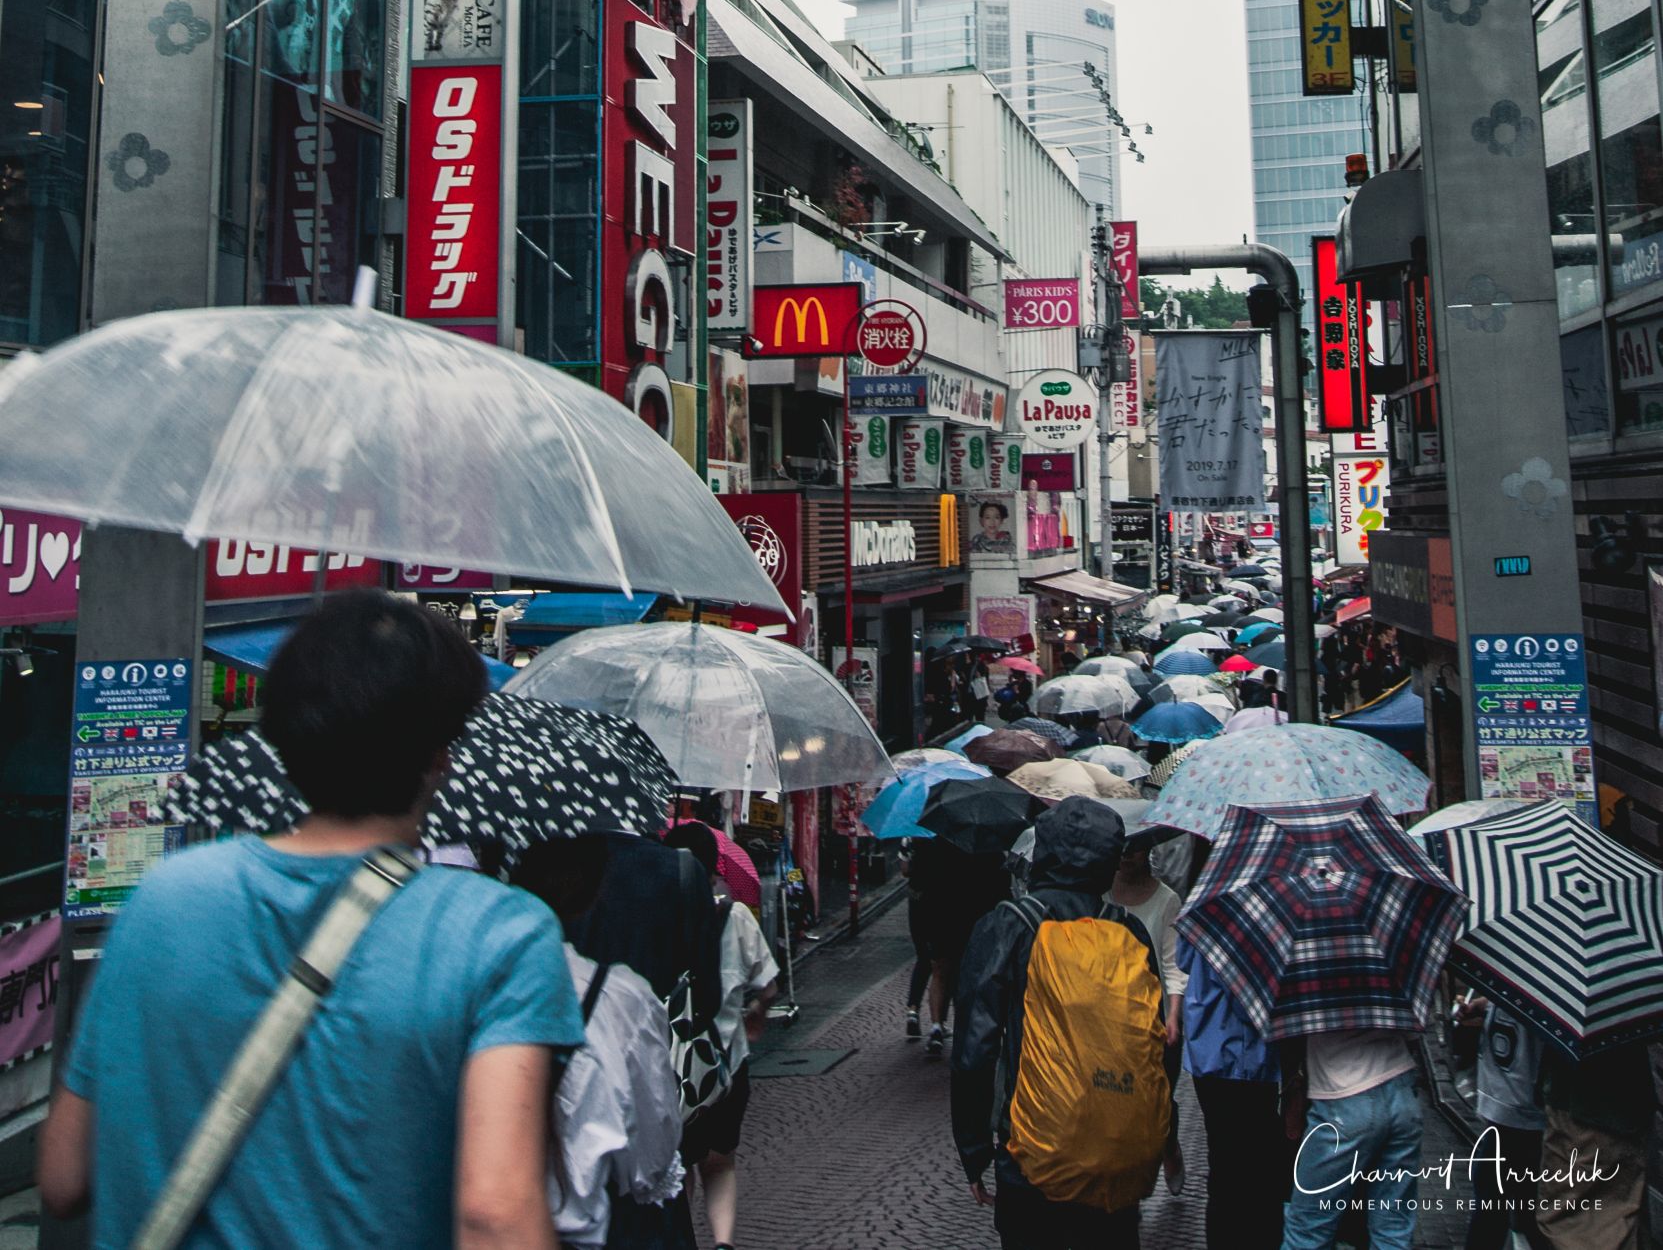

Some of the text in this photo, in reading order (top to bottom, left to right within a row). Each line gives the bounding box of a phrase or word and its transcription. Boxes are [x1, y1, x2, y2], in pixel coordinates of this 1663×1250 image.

[429, 77, 479, 310] OSドラッグ
[1113, 232, 1132, 297] ダイソ
[1012, 299, 1073, 325] ¥300
[1013, 285, 1043, 298] PARIS
[863, 327, 911, 350] 消火栓
[1323, 295, 1346, 371] 吉野家
[1186, 460, 1239, 471] 2019.7.17
[1338, 462, 1352, 535] PURIKURA
